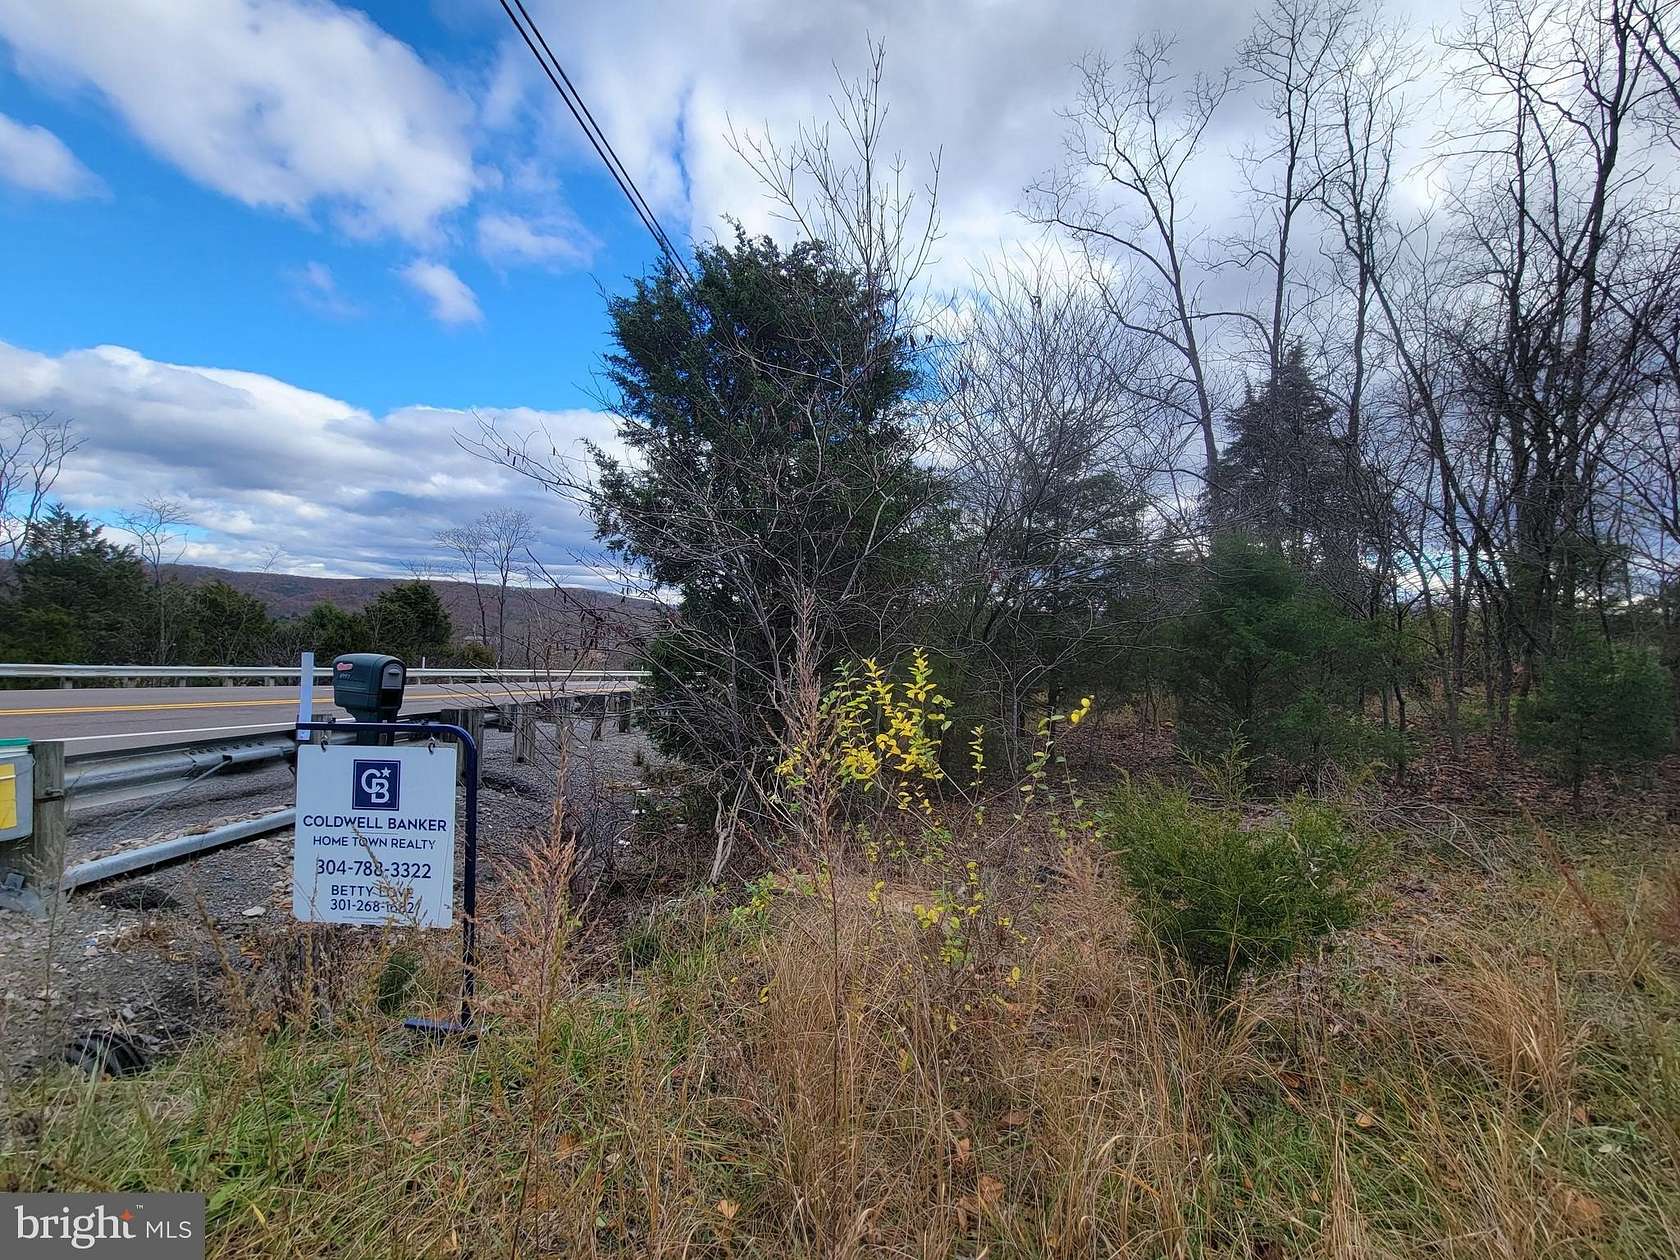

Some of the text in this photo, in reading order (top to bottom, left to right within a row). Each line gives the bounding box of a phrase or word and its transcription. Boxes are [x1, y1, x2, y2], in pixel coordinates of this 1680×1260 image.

[361, 768, 390, 804] CB
[303, 815, 447, 832] COLDWELL BANKER
[313, 835, 436, 850] HOME TOWN REALTY
[317, 858, 432, 879] 304-788-3322
[331, 884, 374, 897] BETTY
